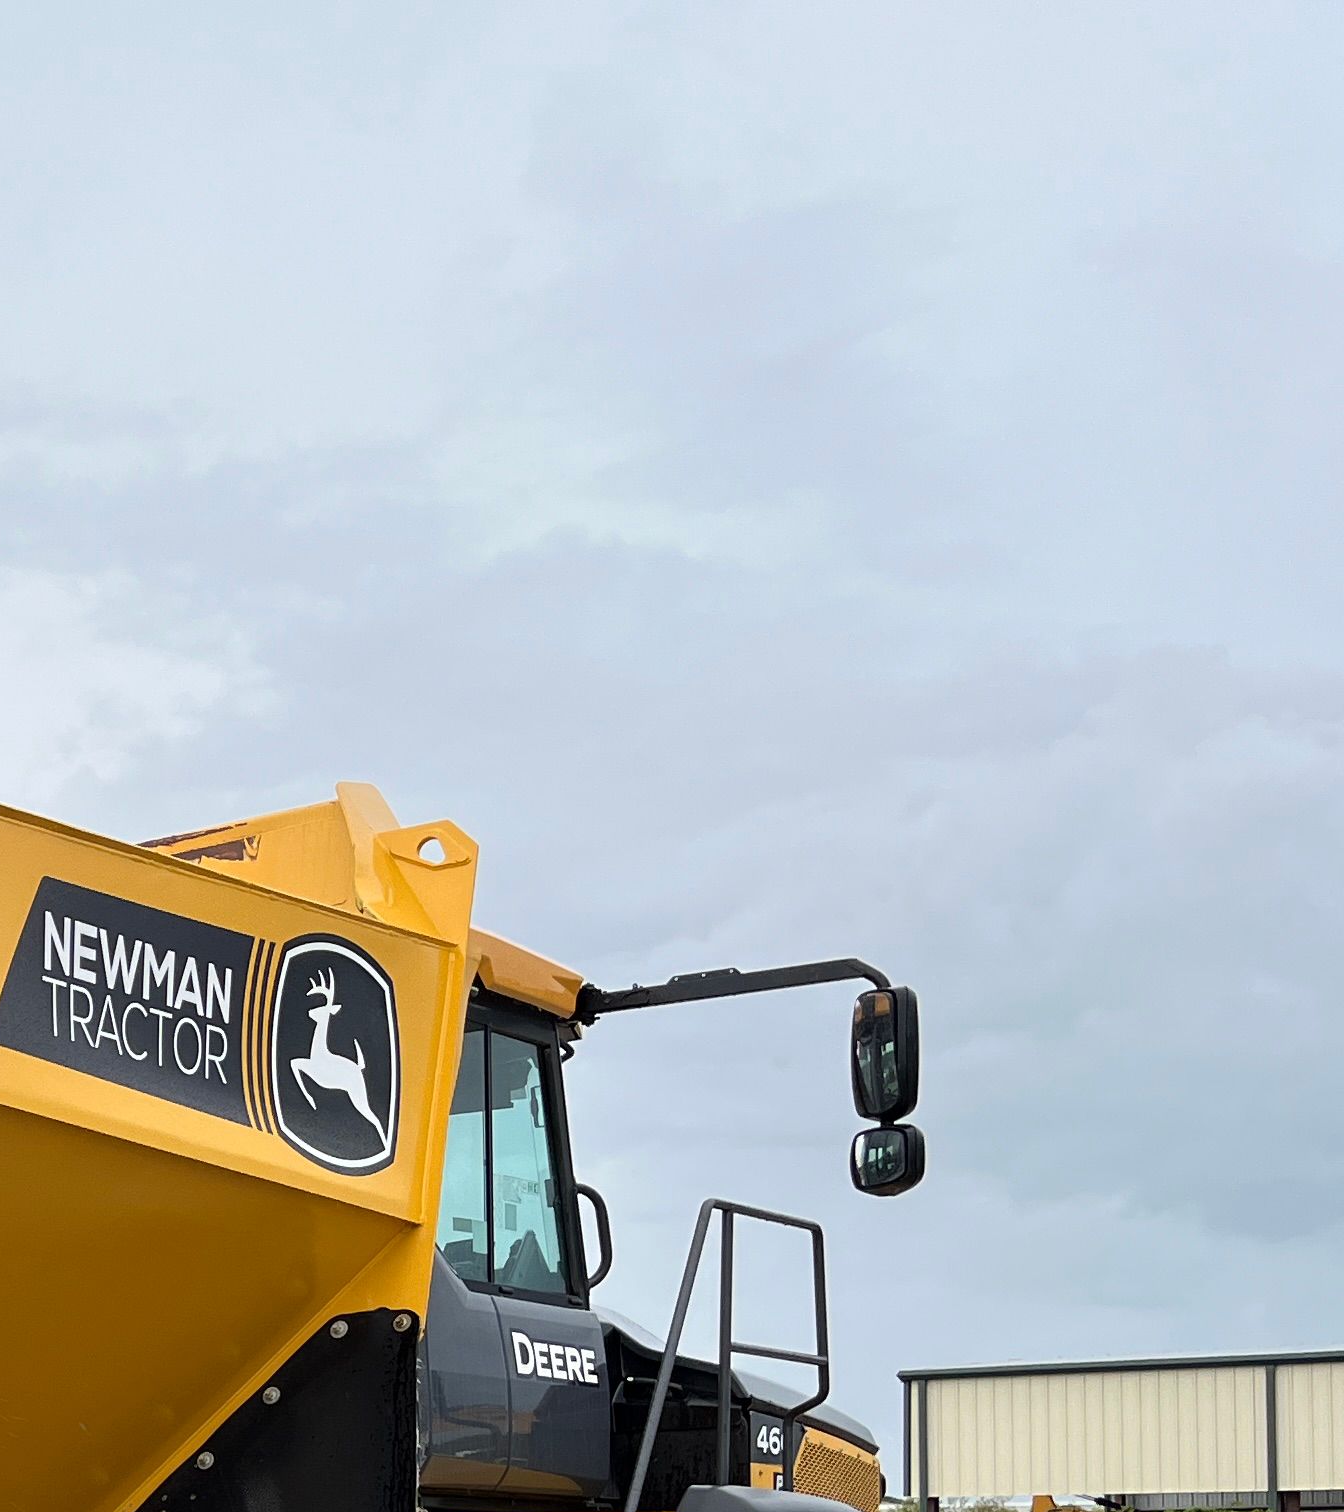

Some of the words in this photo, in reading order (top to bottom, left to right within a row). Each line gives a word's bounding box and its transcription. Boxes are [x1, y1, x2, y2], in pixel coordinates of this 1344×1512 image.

[43, 910, 233, 1024] NEWMAN
[41, 975, 228, 1085] TRACTOR
[511, 1331, 599, 1384] DEERE
